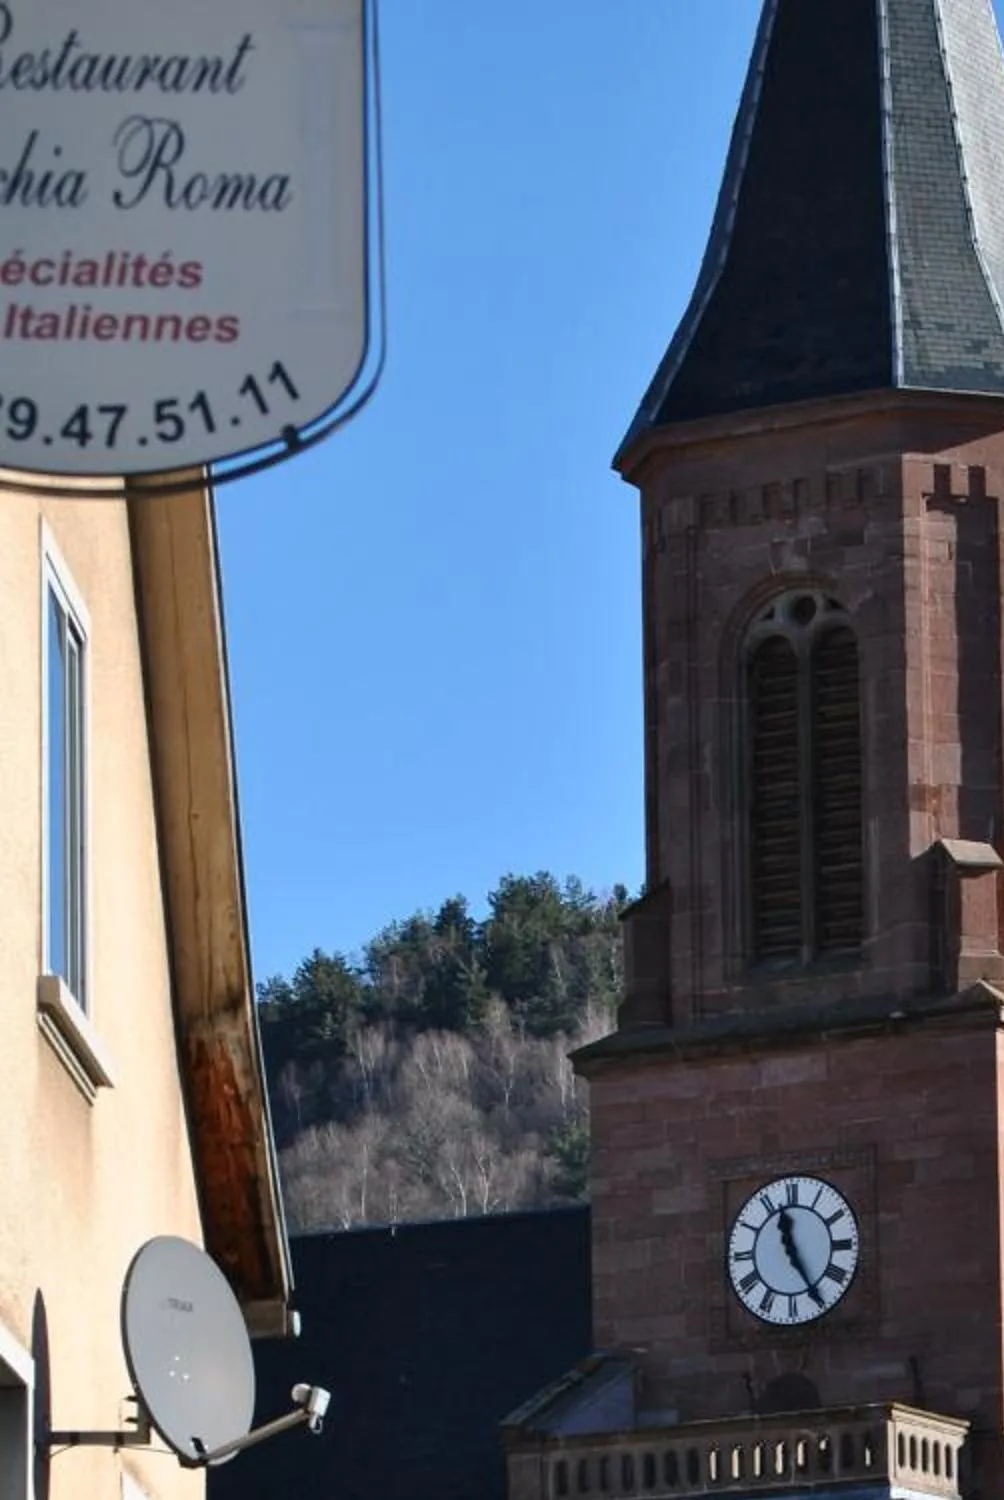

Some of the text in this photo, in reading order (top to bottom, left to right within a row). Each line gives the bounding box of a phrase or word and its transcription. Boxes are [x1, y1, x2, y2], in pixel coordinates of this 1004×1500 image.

[112, 114, 293, 212] Roma
[4, 303, 240, 344] Italiennes
[0, 360, 300, 448] 9.47.51.11
